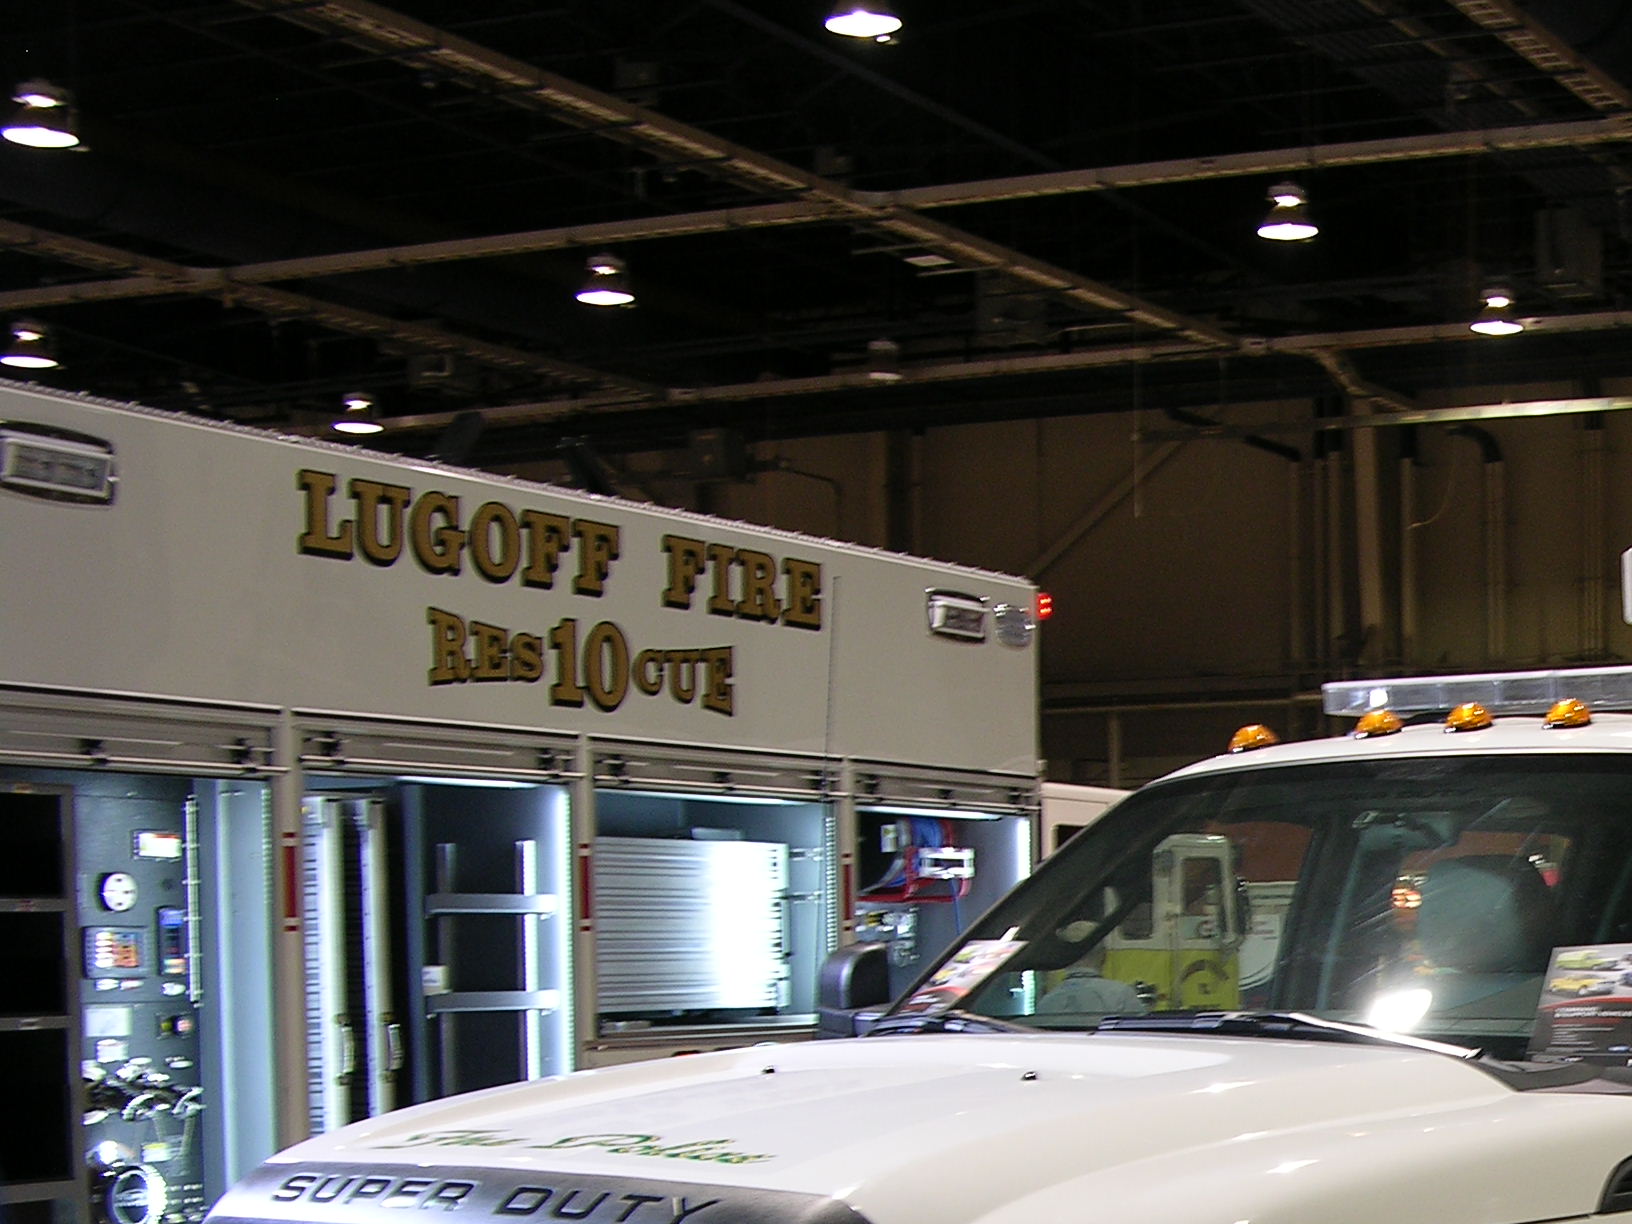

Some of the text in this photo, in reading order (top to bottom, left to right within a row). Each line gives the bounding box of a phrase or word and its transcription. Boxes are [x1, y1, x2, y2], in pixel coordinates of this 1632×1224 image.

[296, 468, 823, 631] LUGOFF FIRE
[271, 1173, 477, 1212] SUPER
